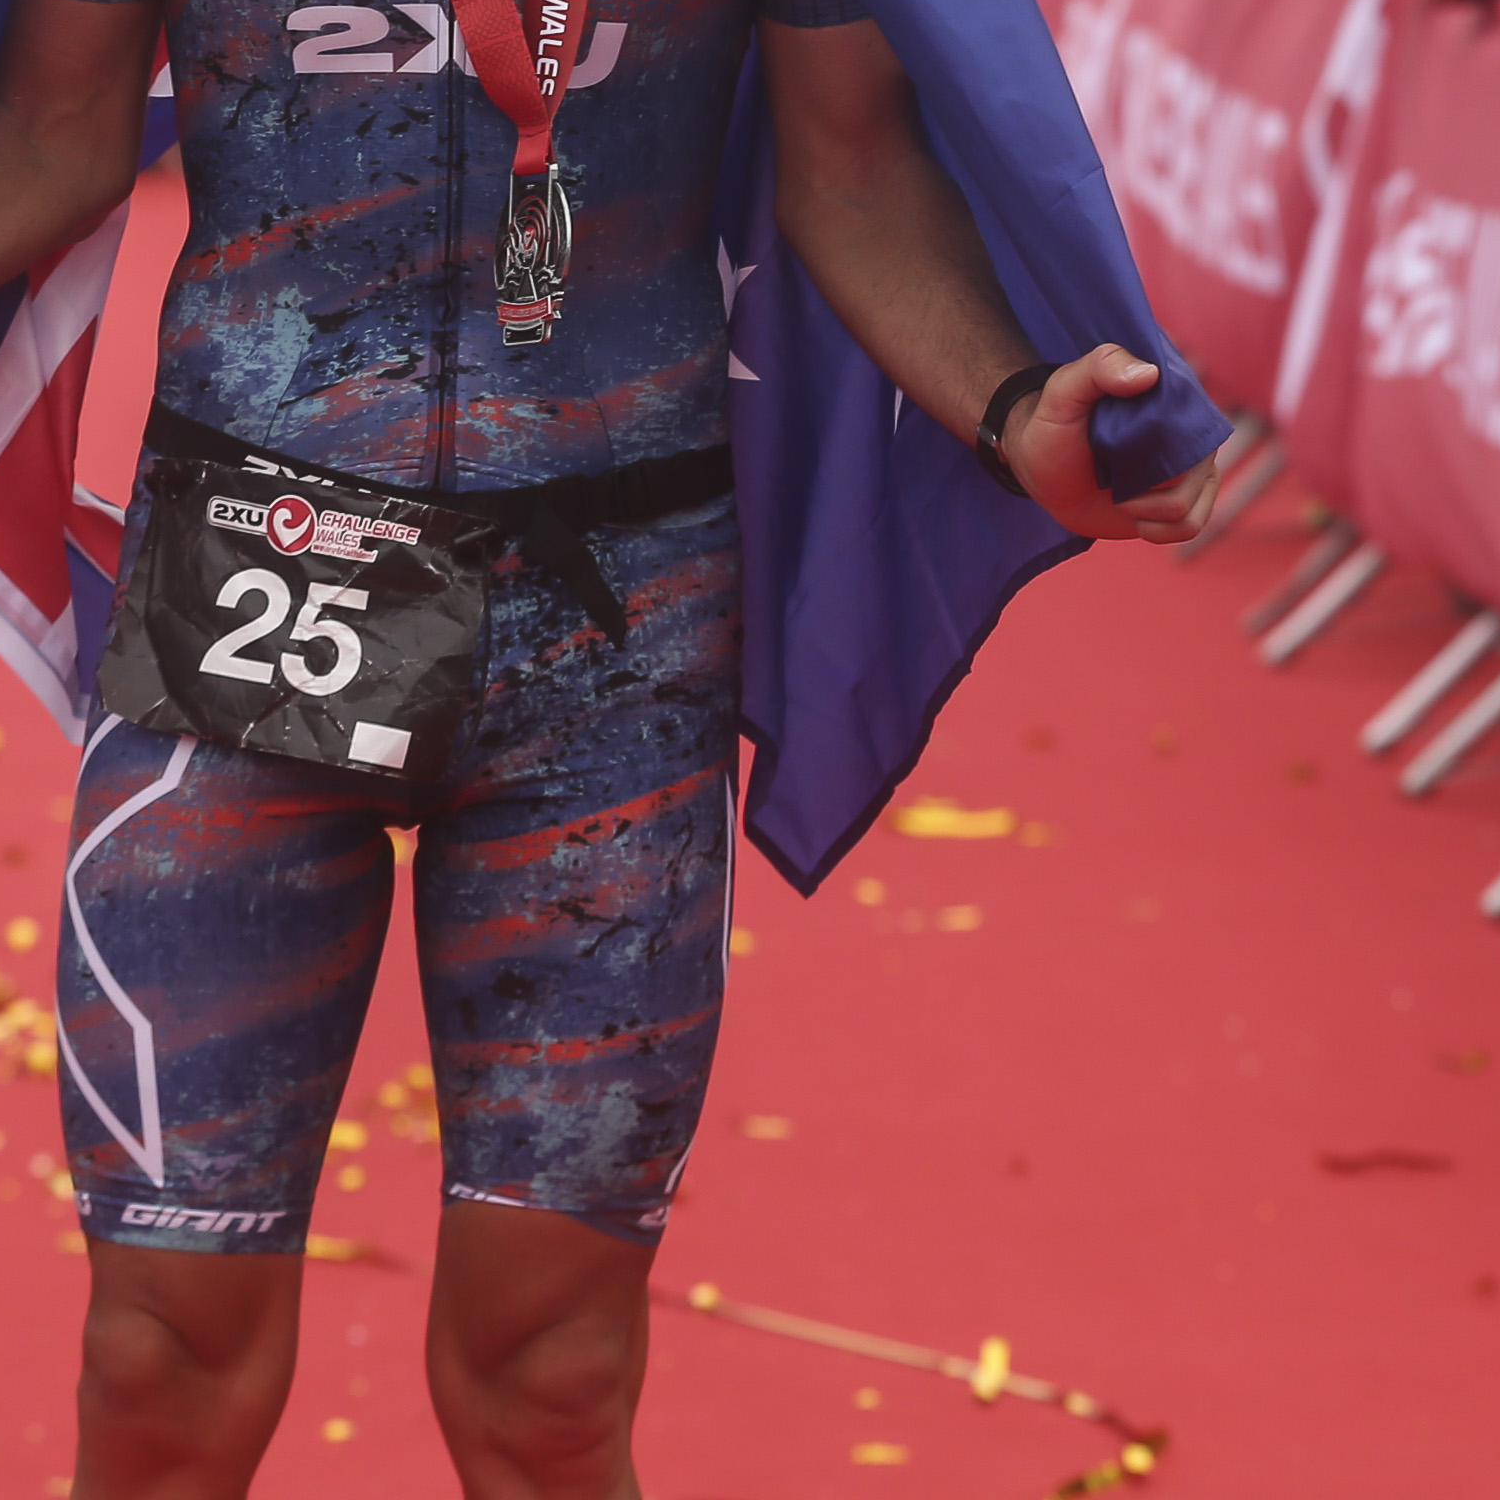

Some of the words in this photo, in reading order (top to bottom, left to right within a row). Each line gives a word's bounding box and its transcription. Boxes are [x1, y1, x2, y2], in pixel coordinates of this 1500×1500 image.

[213, 502, 264, 527] 2XU
[320, 512, 420, 544] CHALLENGE
[315, 529, 361, 549] WALES
[199, 567, 370, 698] 25
[119, 1203, 288, 1234] GIANT
